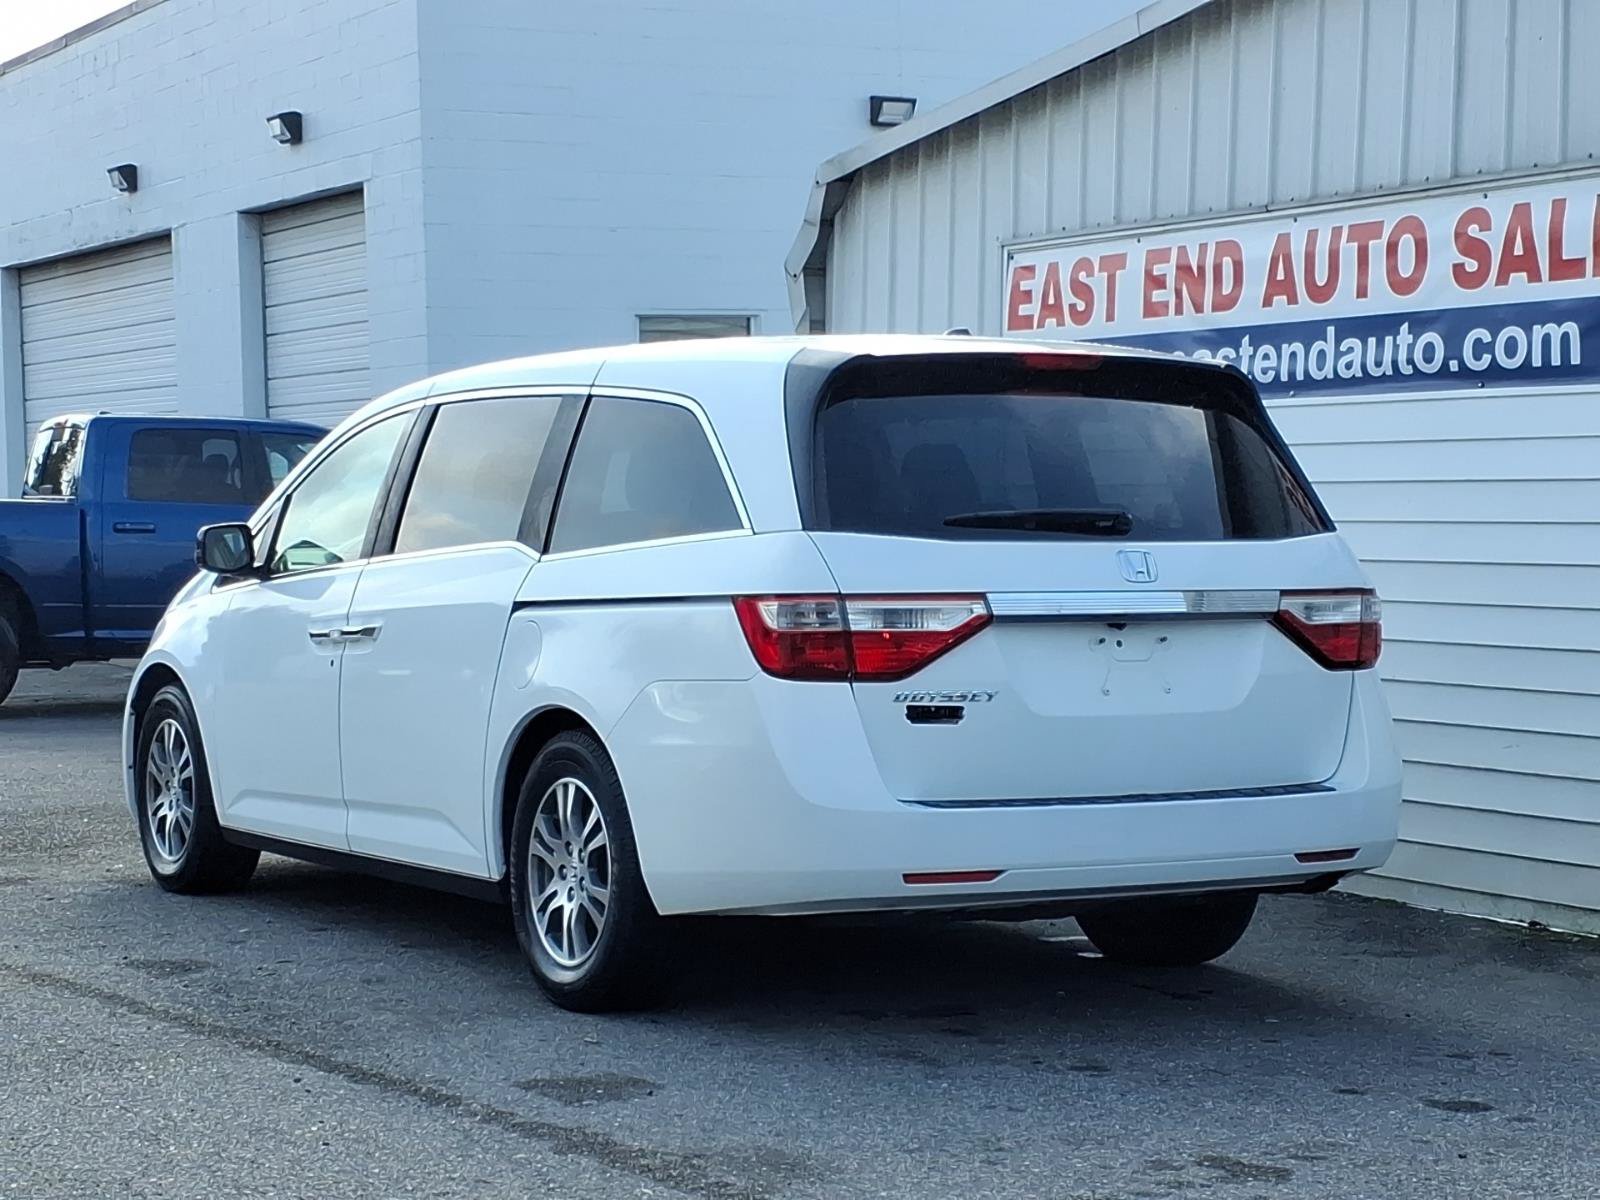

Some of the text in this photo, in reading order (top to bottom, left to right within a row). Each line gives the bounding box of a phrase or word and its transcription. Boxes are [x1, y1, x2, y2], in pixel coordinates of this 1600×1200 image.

[1006, 193, 1600, 331] EAST END AUTO SAL
[1172, 320, 1581, 386] tendauto.com
[892, 690, 999, 703] ODYSSEY
